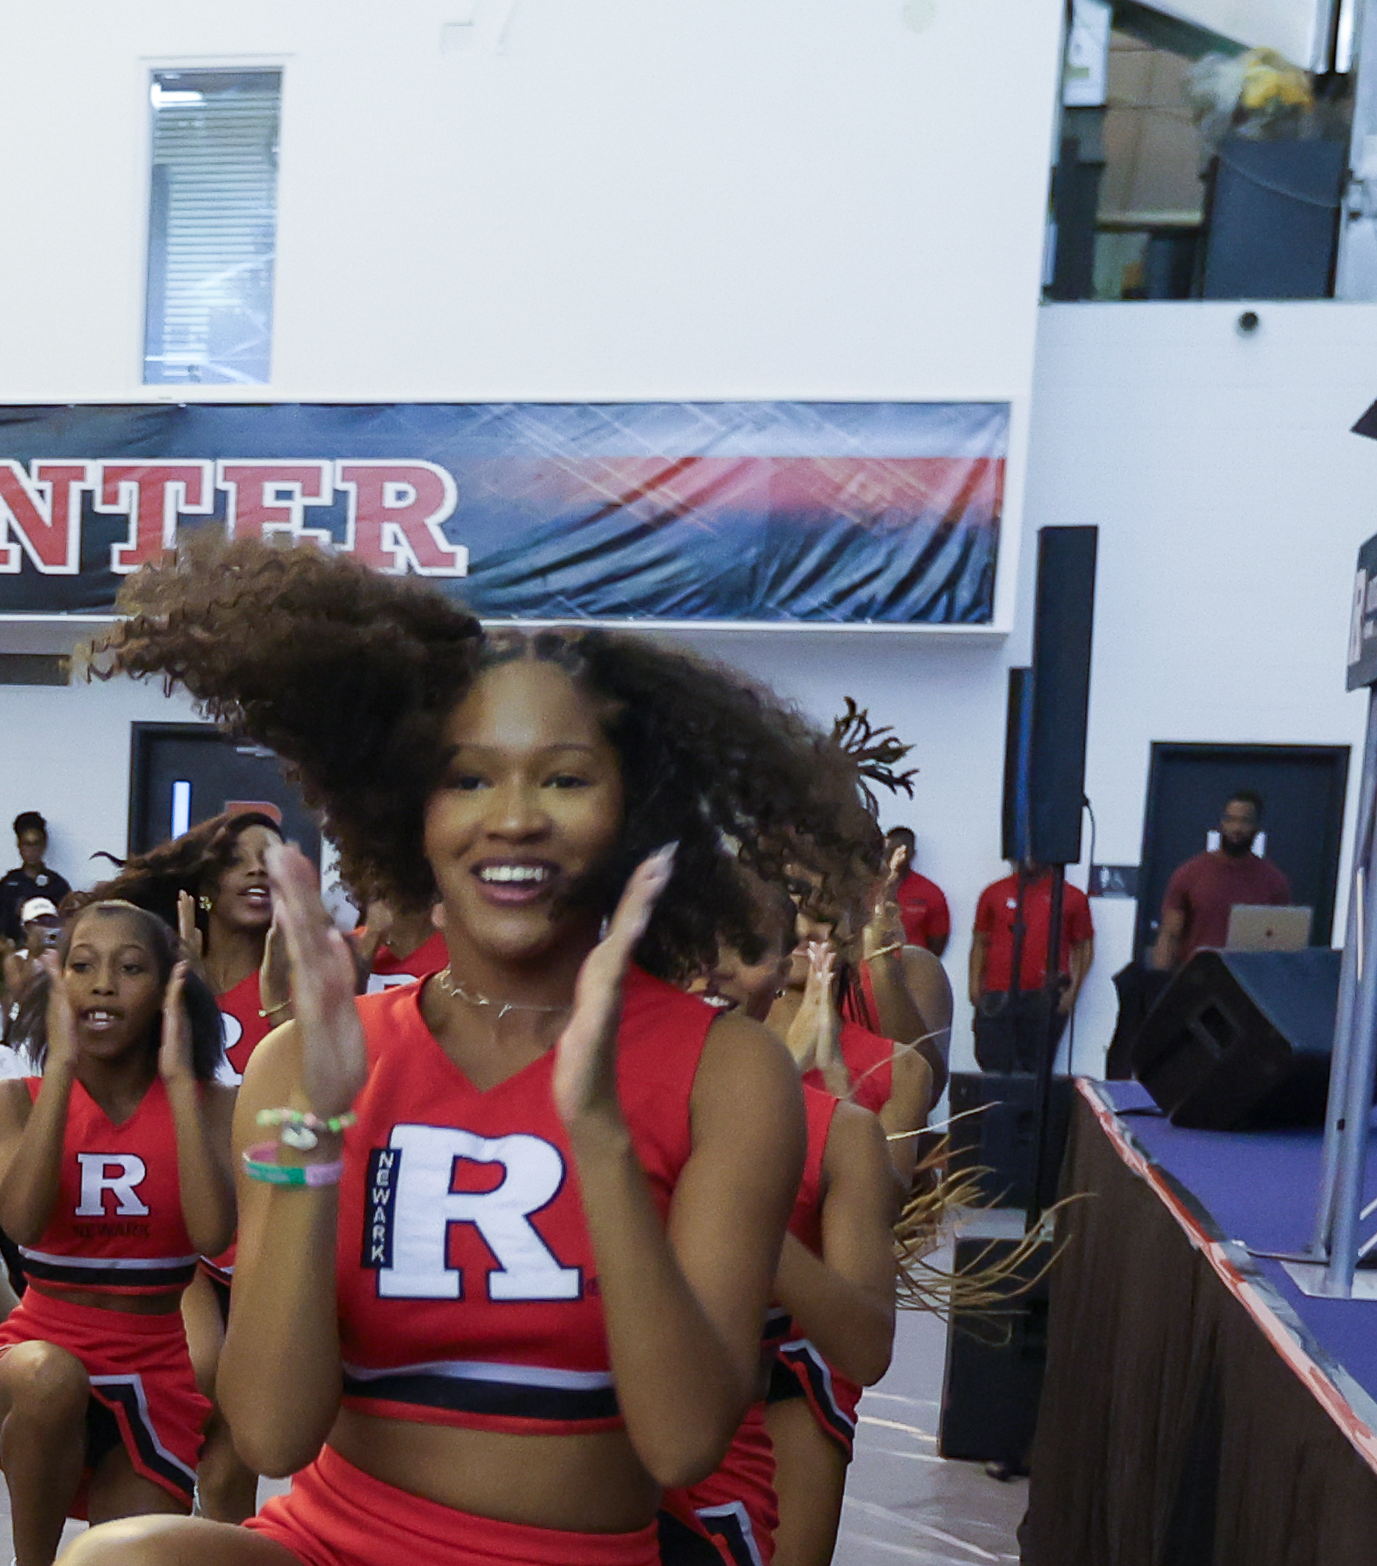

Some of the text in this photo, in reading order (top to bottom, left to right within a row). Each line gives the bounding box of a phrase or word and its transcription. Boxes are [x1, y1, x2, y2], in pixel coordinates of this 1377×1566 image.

[74, 1152, 150, 1217] R
[370, 1151, 395, 1263] NEWARK
[375, 1122, 583, 1302] R
